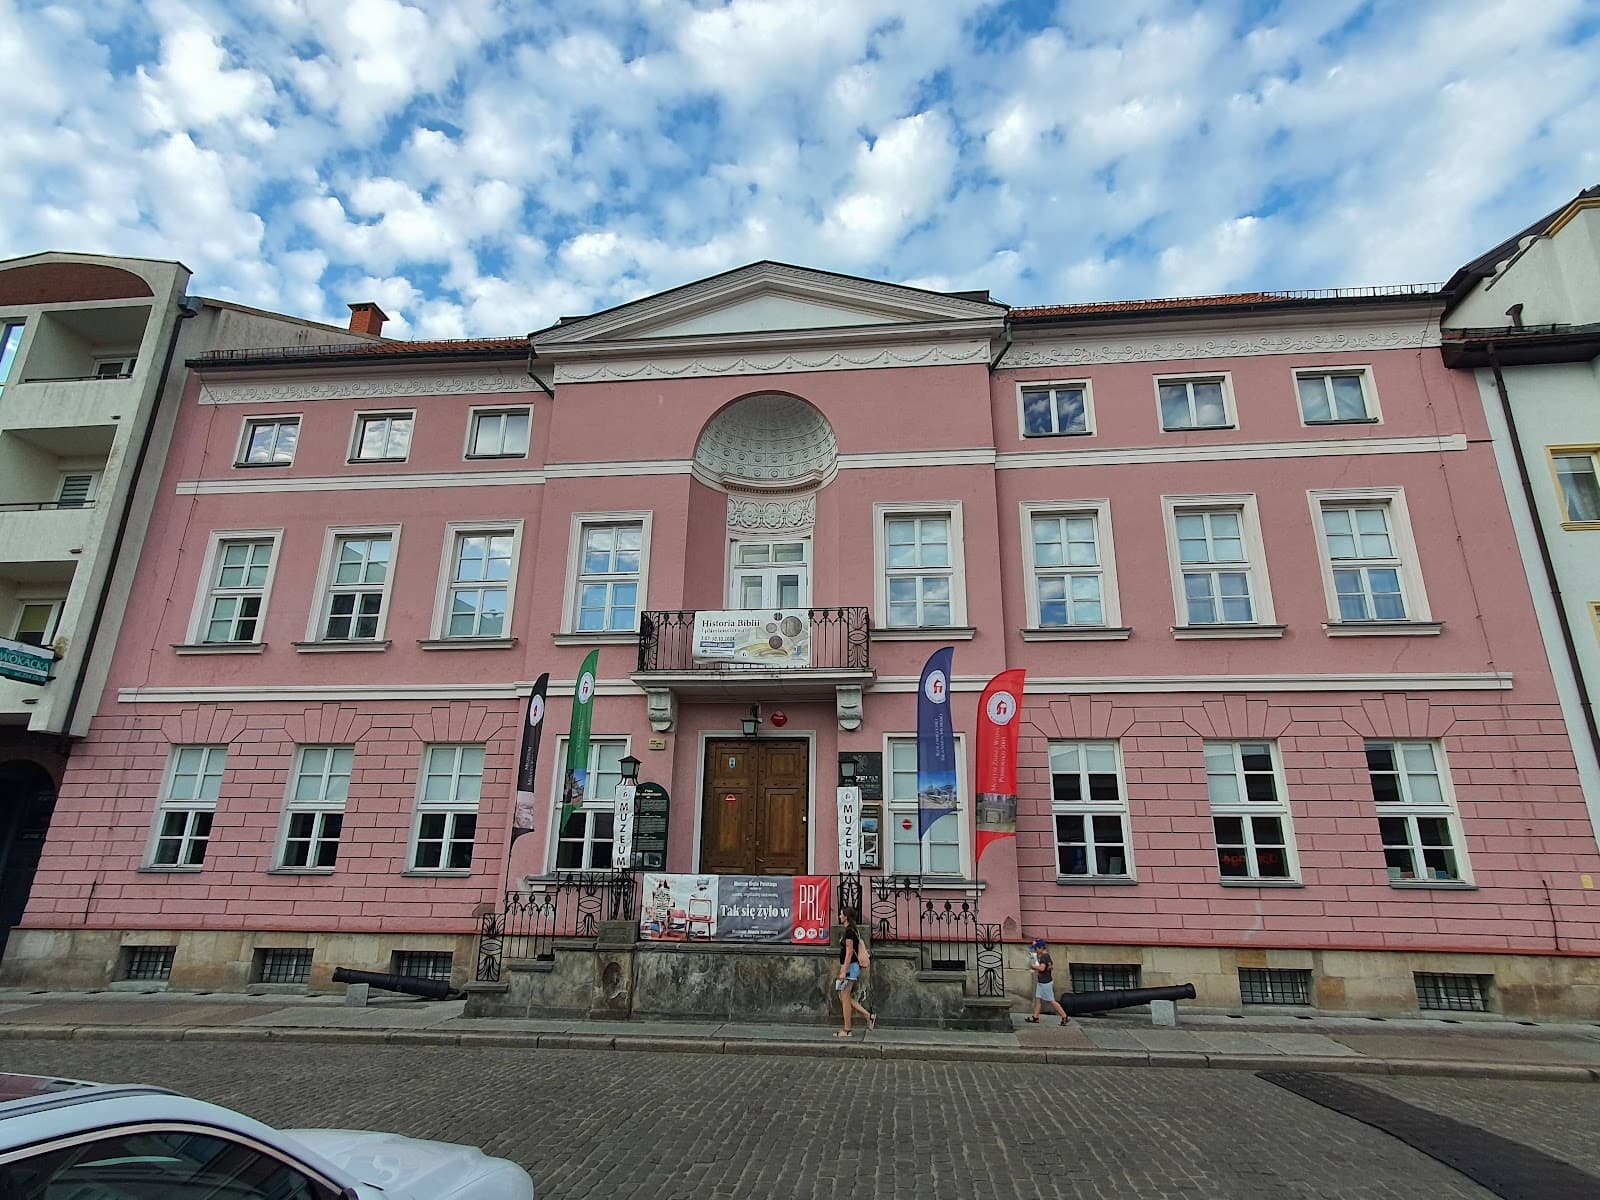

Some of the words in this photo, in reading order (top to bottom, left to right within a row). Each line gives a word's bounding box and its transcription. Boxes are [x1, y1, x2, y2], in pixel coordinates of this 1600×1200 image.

[702, 619, 735, 627] Historia
[737, 619, 760, 627] Biblii
[616, 802, 628, 866] MUZEUM
[843, 804, 853, 871] MUZEUM
[720, 904, 740, 918] Tak
[741, 903, 756, 920] się
[757, 903, 779, 920] żyło
[780, 907, 790, 918] w
